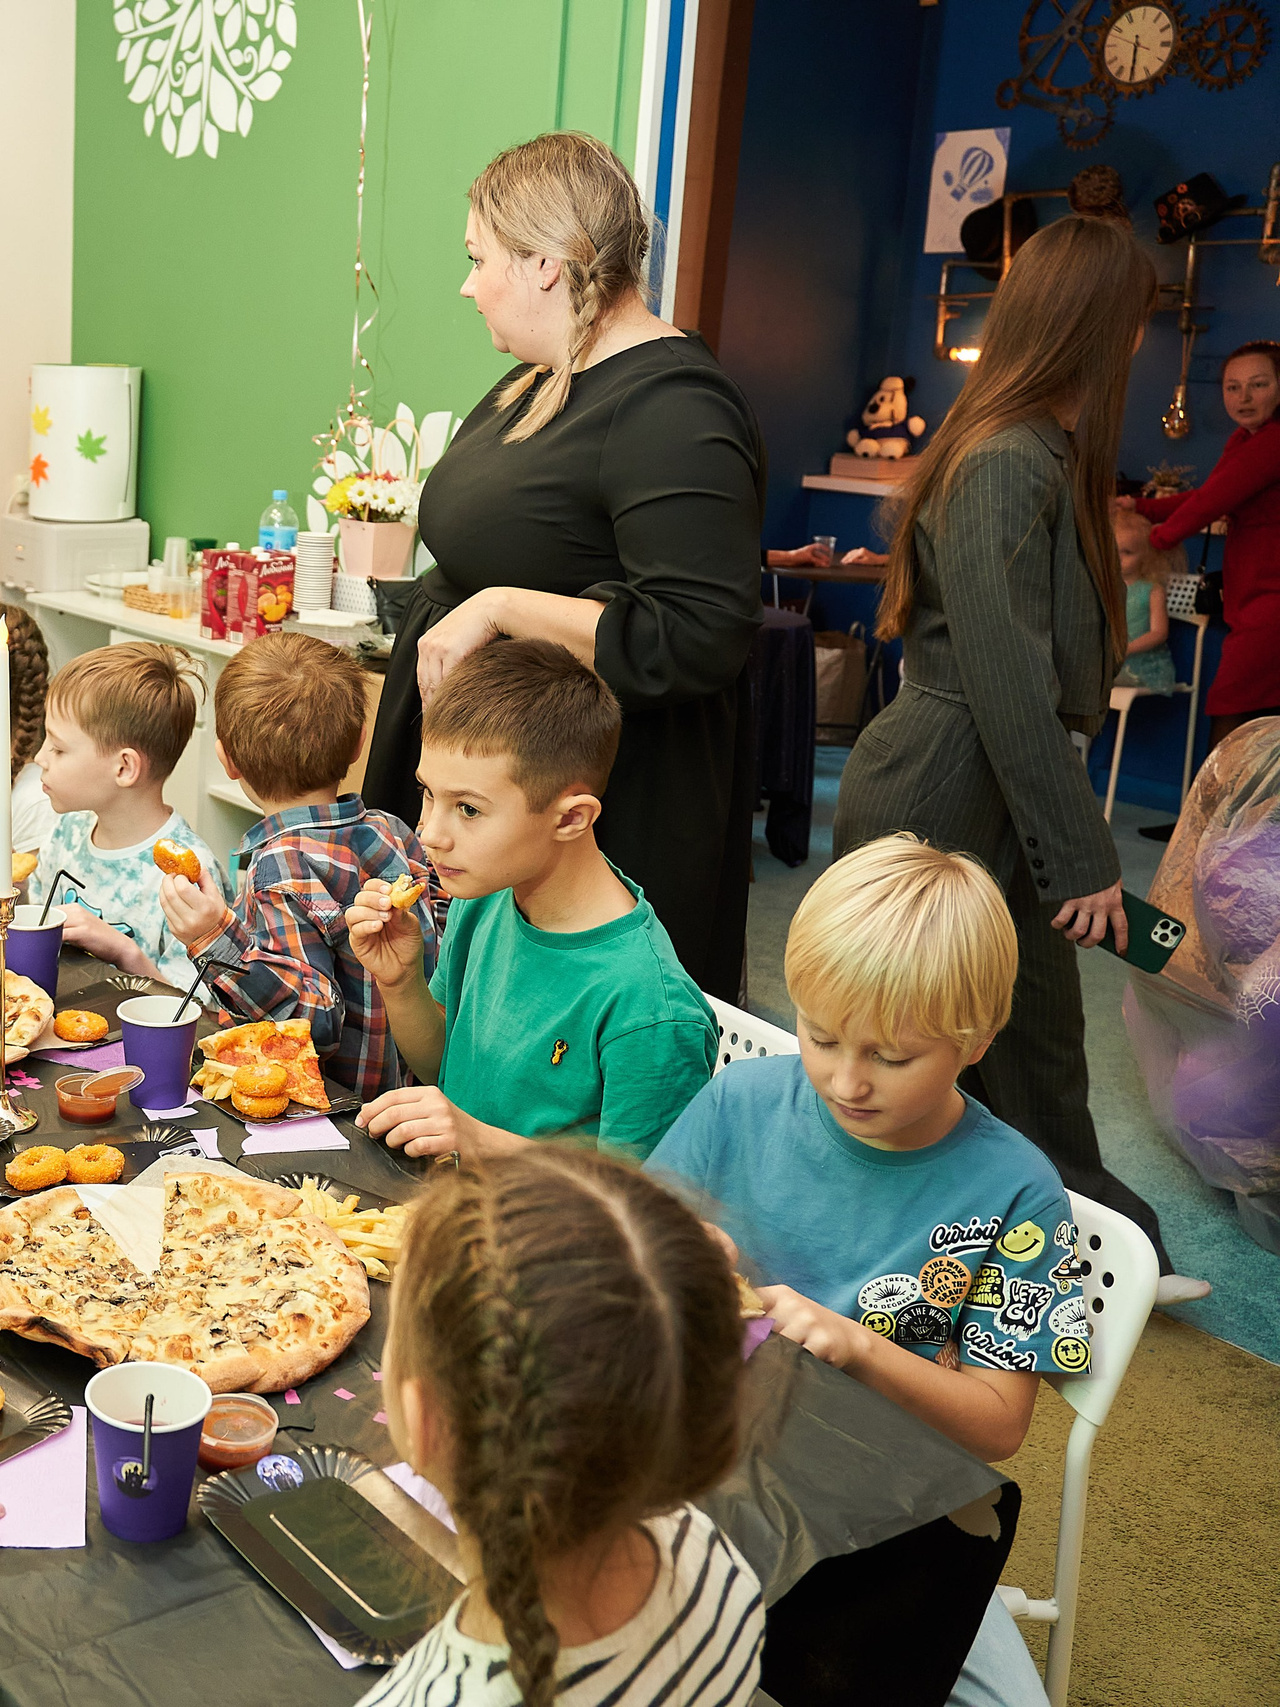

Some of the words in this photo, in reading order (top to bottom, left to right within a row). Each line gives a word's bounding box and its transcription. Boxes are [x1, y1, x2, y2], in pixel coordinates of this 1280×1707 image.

[921, 1269, 931, 1293] RIDIN
[928, 1260, 944, 1270] THE
[946, 1260, 967, 1279] WAVE
[862, 1281, 882, 1295] PALM
[929, 1283, 951, 1300] UNTIL
[937, 1288, 964, 1303] GRAVE
[970, 1284, 993, 1294] ARE
[1012, 1280, 1053, 1308] LET'S
[881, 1293, 915, 1310] DEGREES
[1055, 1302, 1074, 1317] PALM
[898, 1311, 912, 1326] FOR
[910, 1306, 926, 1317] THE
[928, 1308, 949, 1326] WAVE
[1006, 1302, 1036, 1326] GO
